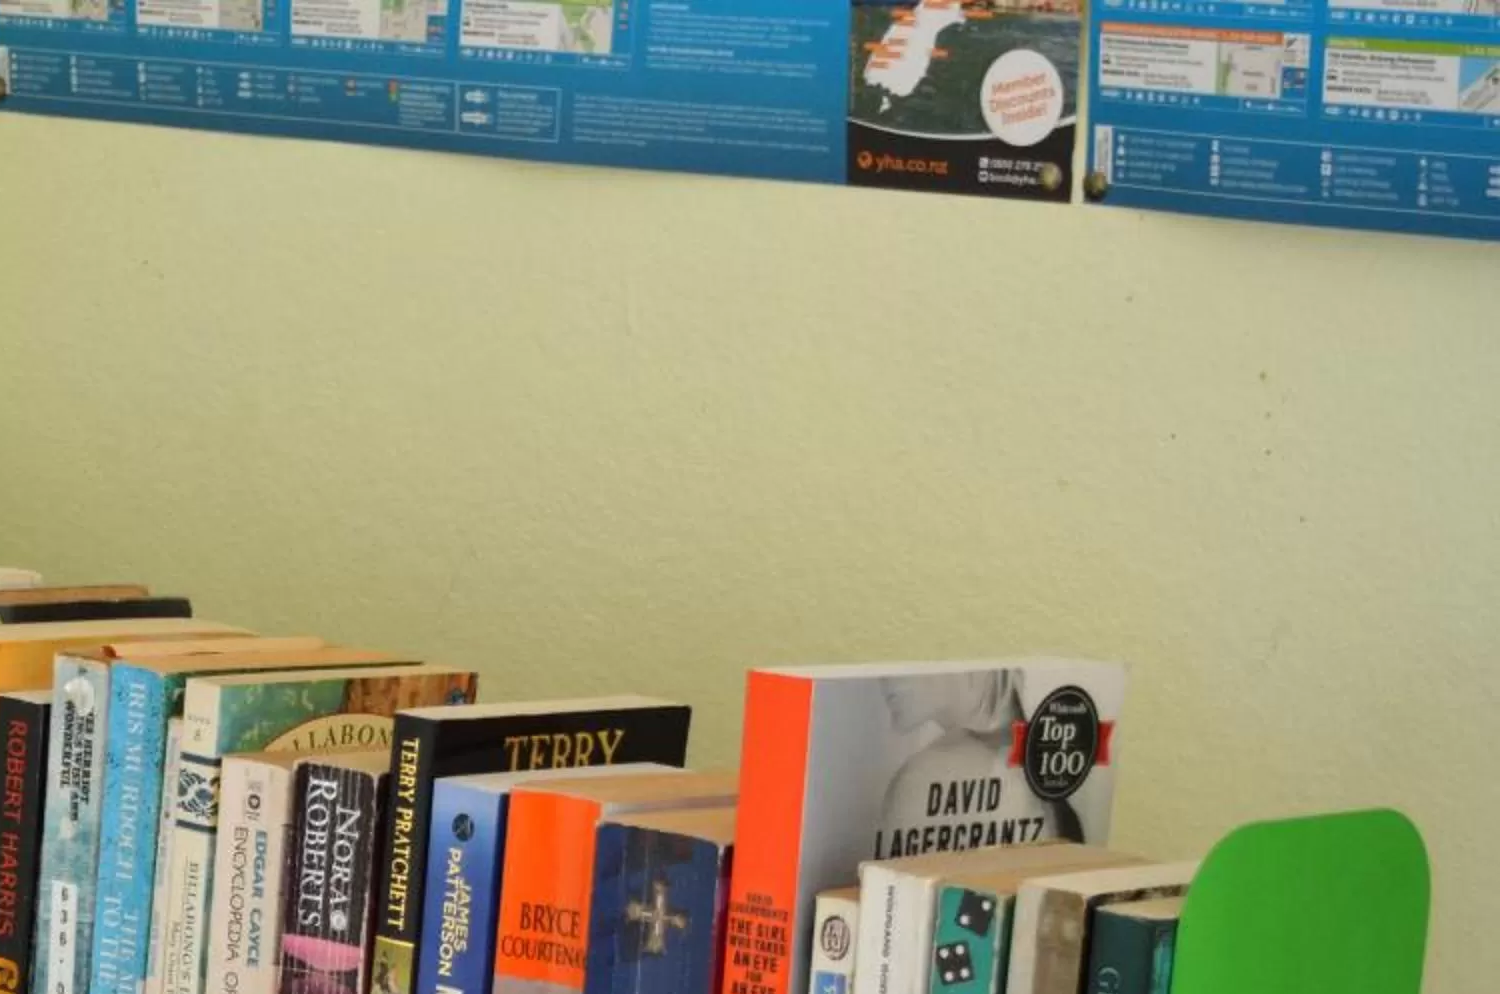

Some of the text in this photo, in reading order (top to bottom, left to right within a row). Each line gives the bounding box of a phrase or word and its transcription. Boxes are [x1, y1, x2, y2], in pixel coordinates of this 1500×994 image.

[875, 153, 949, 175] yha.co.nz
[505, 728, 625, 772] TERRY
[1040, 716, 1077, 751] Top
[3, 719, 28, 826] ROBERT
[115, 681, 146, 881] IRIS MURDOCH
[1039, 751, 1085, 776] 100
[926, 777, 1002, 817] DAVID
[300, 775, 340, 928] ROBERTS
[329, 806, 361, 904] NORA
[387, 737, 420, 932] TERRY PRATCHETT
[103, 895, 121, 928] TO
[224, 825, 249, 962] ENCYCLOPEDIA
[247, 830, 268, 968] EDGAR CAYCE
[437, 847, 462, 977] PATTERSON
[453, 876, 472, 953] JAMES
[519, 901, 581, 938] BRYCE
[730, 916, 753, 936] THE
[98, 931, 117, 987] THE
[733, 949, 779, 974] AN EYE
